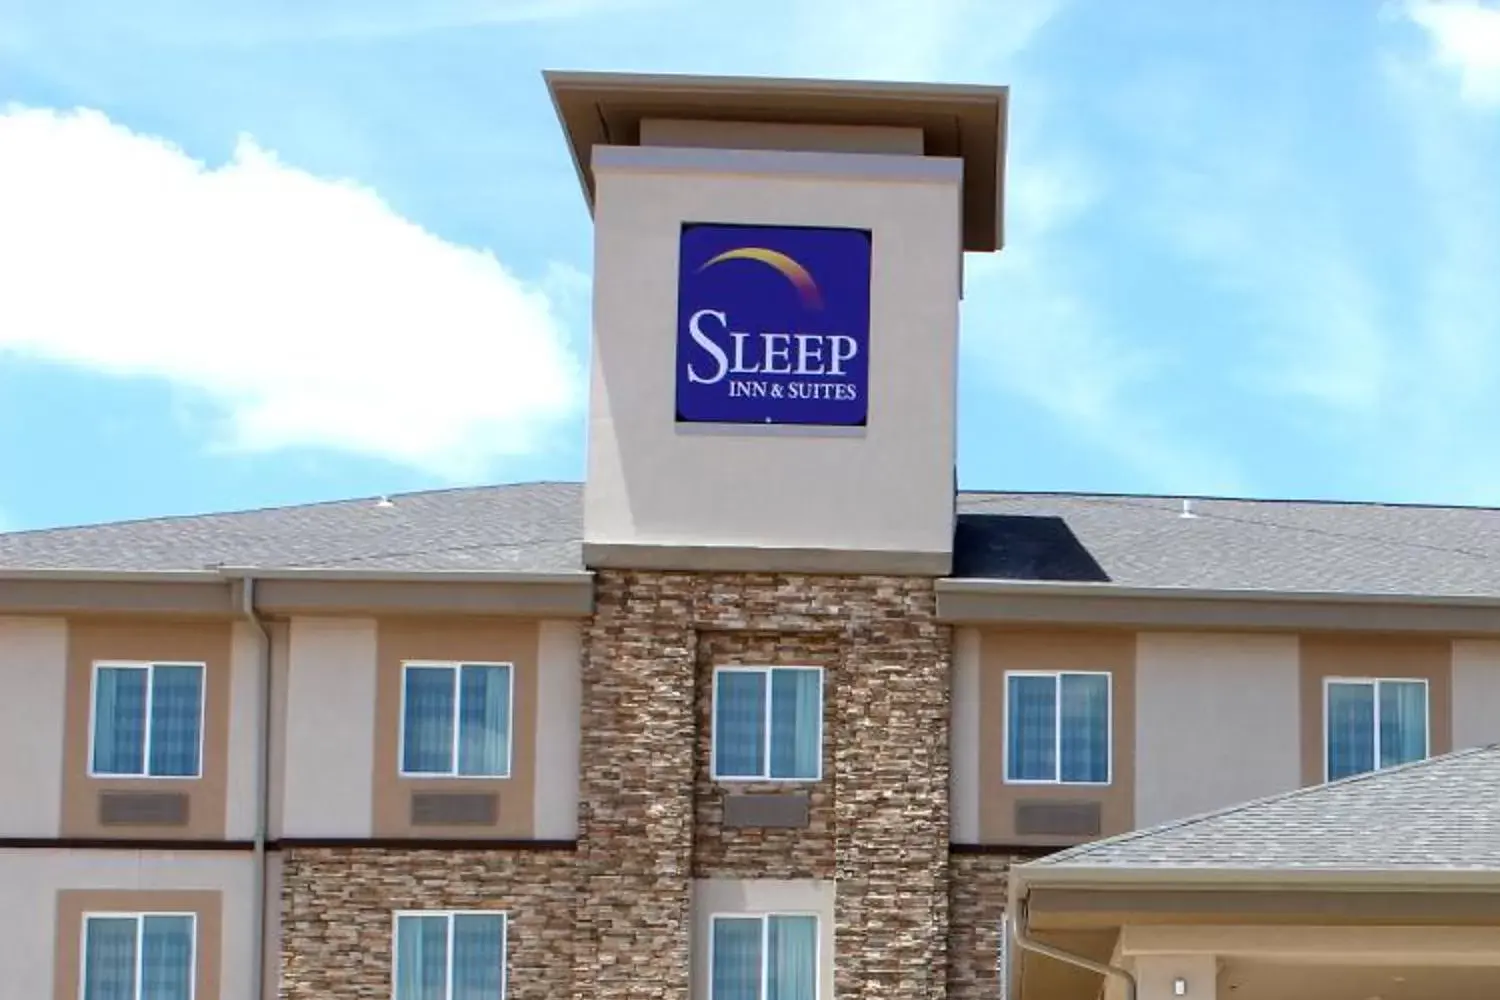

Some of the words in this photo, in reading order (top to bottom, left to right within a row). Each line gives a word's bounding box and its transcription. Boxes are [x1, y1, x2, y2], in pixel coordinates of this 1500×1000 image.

[688, 309, 858, 384] SLEEP
[729, 382, 767, 397] INN
[770, 384, 785, 398] &
[788, 382, 857, 400] SUITES
